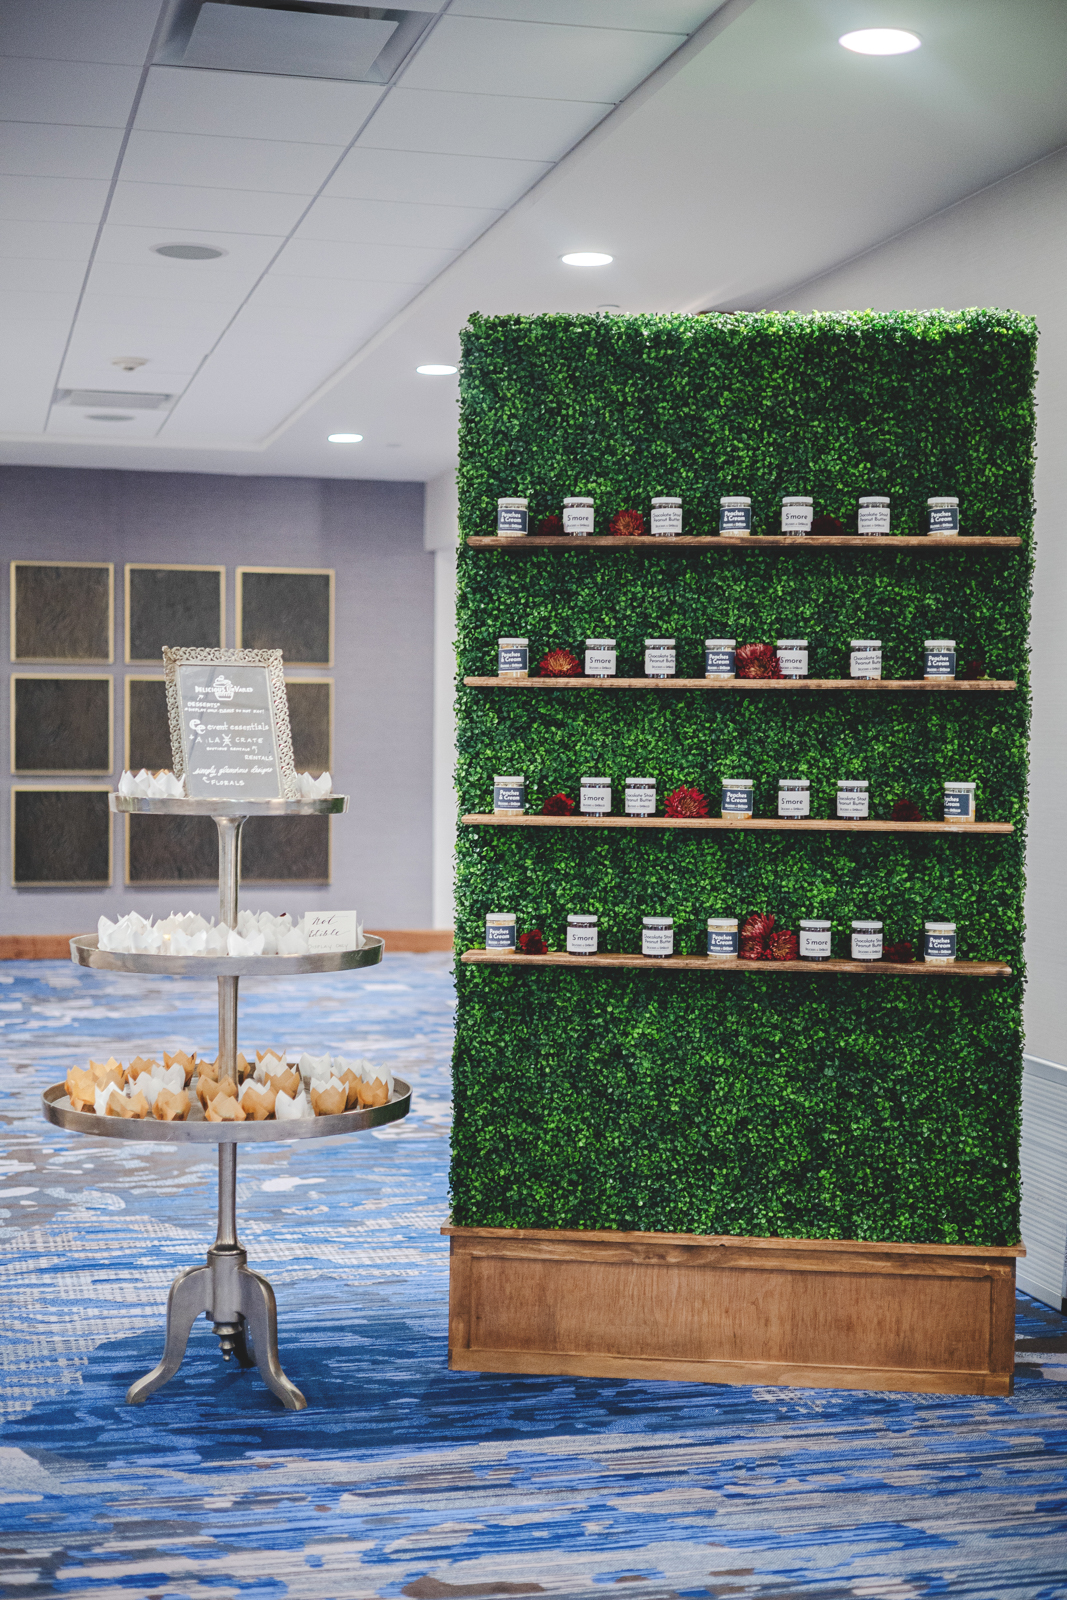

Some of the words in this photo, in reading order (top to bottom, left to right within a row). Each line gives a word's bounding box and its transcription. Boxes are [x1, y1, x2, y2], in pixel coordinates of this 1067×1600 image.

[207, 722, 228, 730] event
[230, 722, 269, 731] essentials
[192, 765, 217, 778] simply
[251, 765, 274, 775] designs
